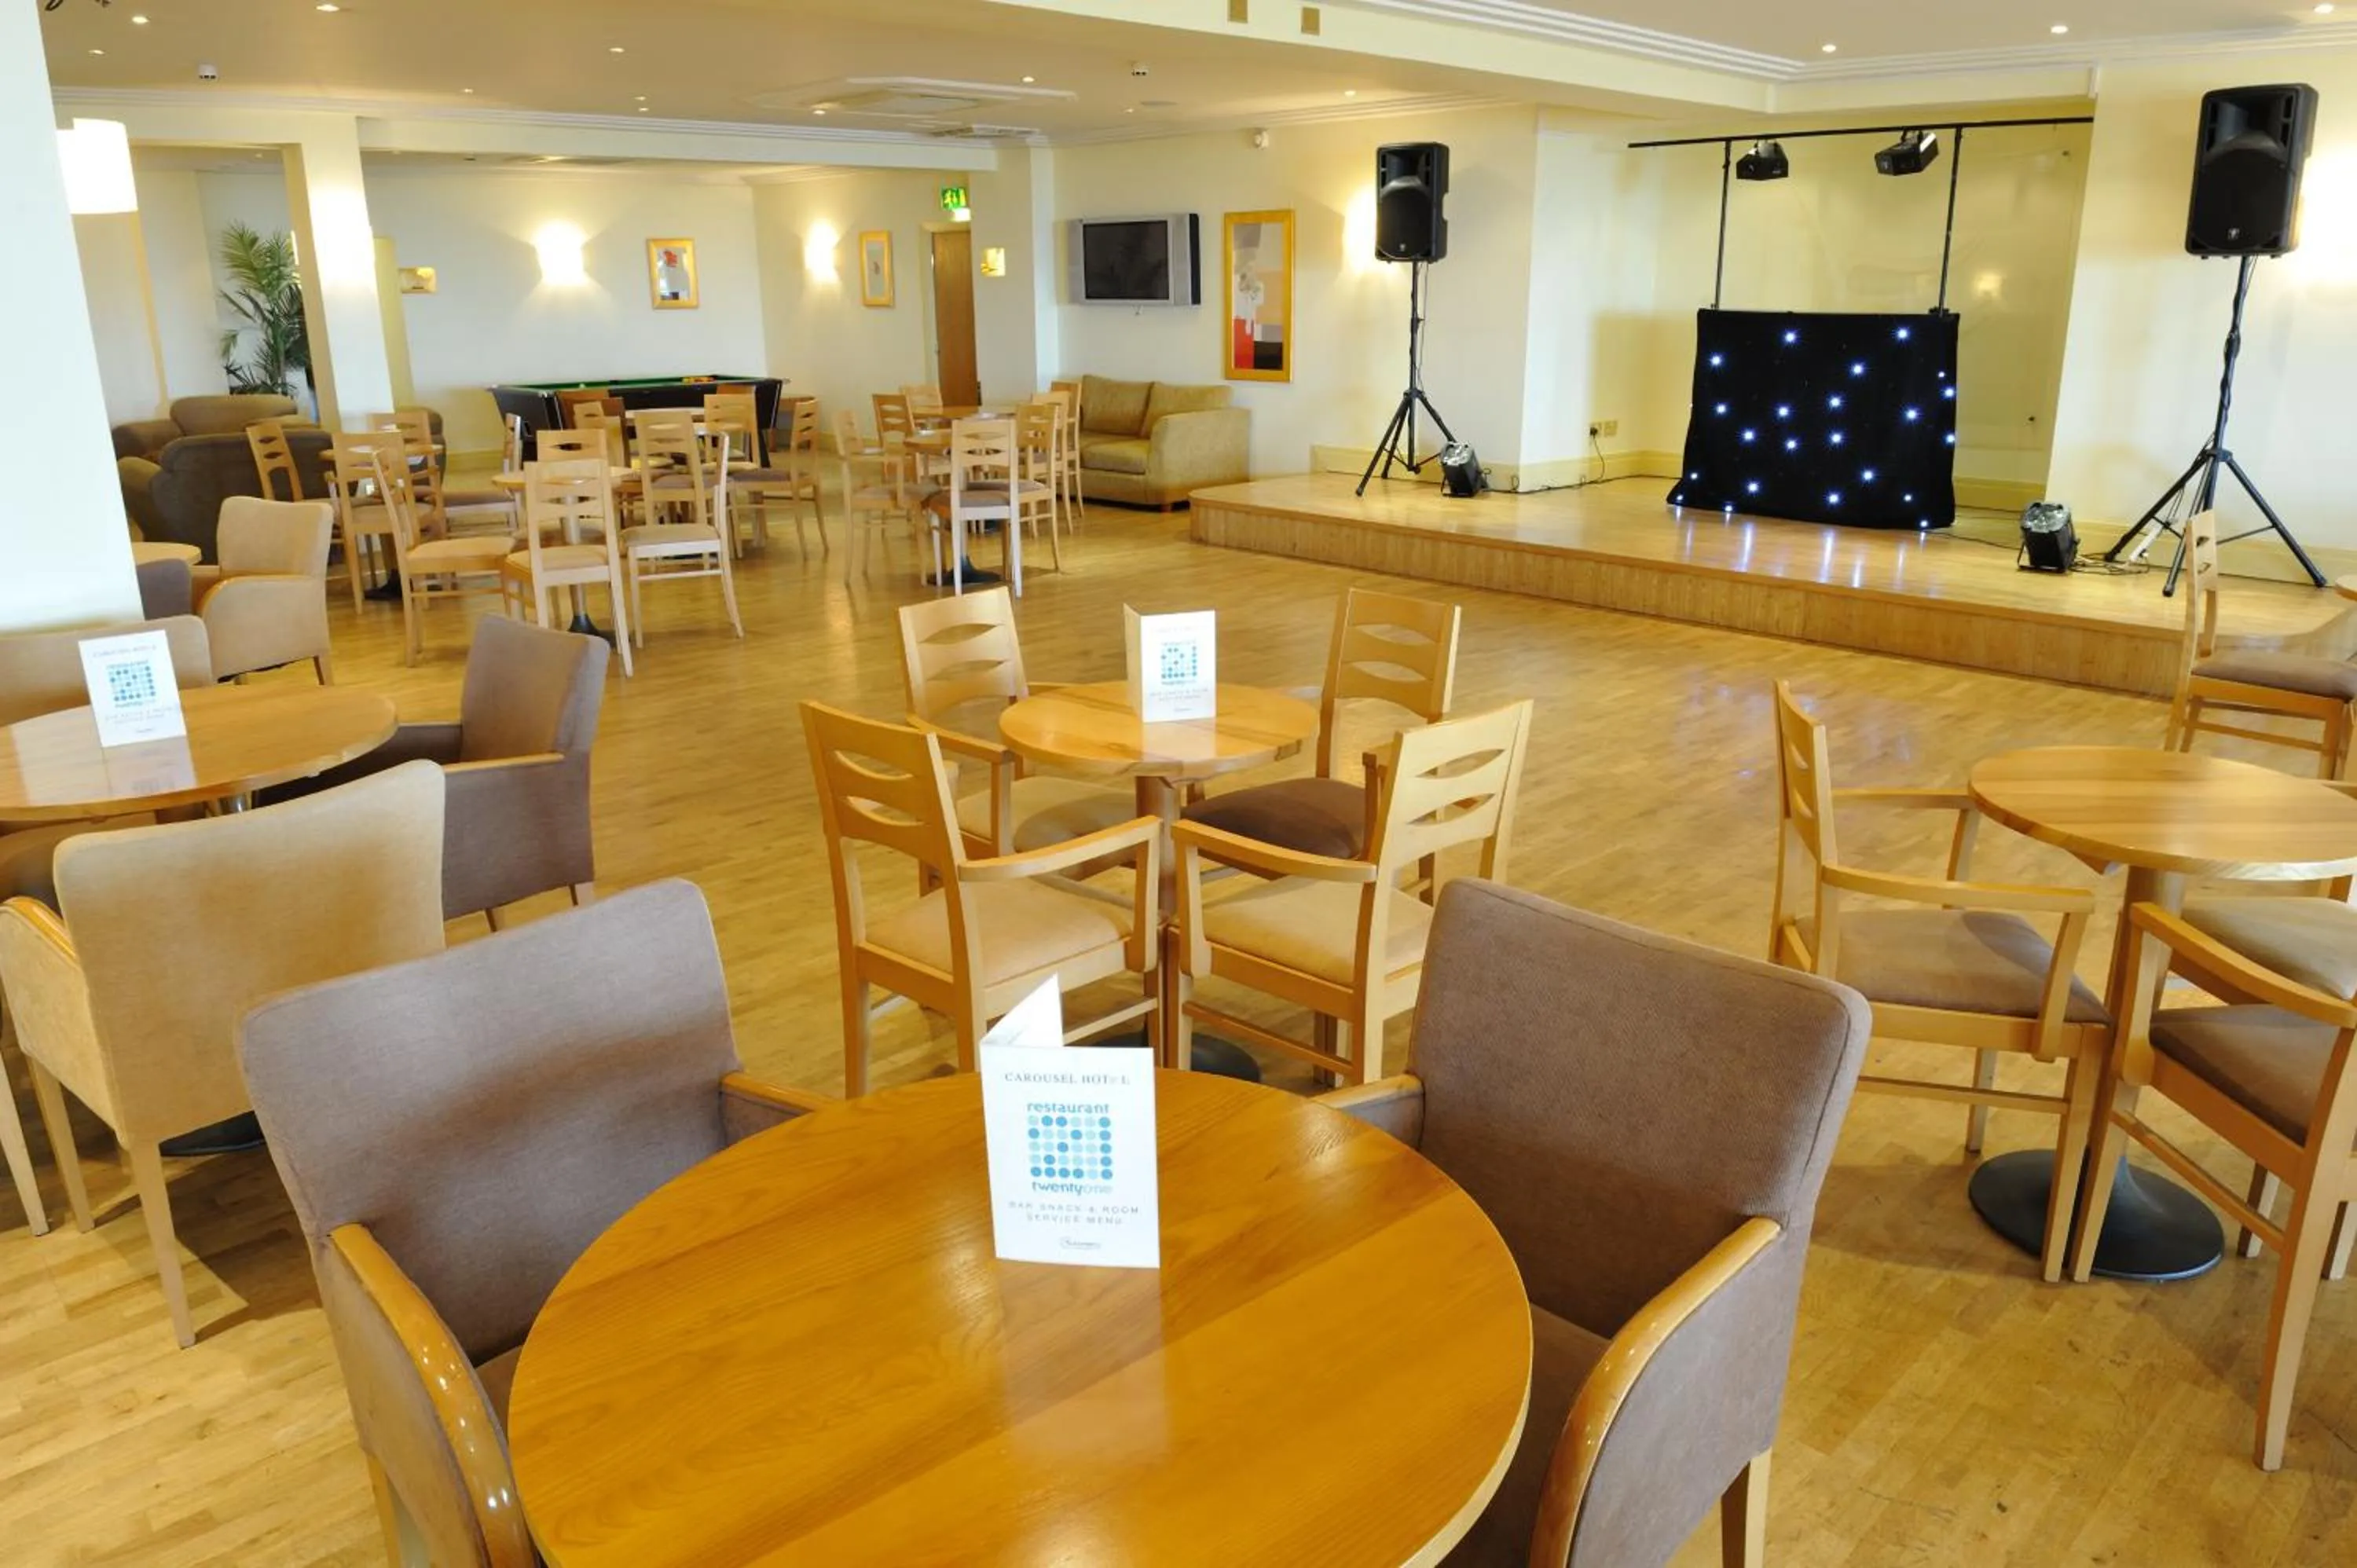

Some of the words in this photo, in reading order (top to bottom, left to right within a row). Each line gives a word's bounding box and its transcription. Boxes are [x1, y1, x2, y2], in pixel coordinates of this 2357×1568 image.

[1005, 1072, 1077, 1085] CAROUSEL
[1026, 1101, 1110, 1114] restaurant
[1032, 1181, 1113, 1196] twentyone
[1039, 1203, 1083, 1212] SNACK
[1102, 1205, 1139, 1214] ROOM
[1027, 1214, 1081, 1224] SERVICE
[1086, 1216, 1123, 1225] MENU
